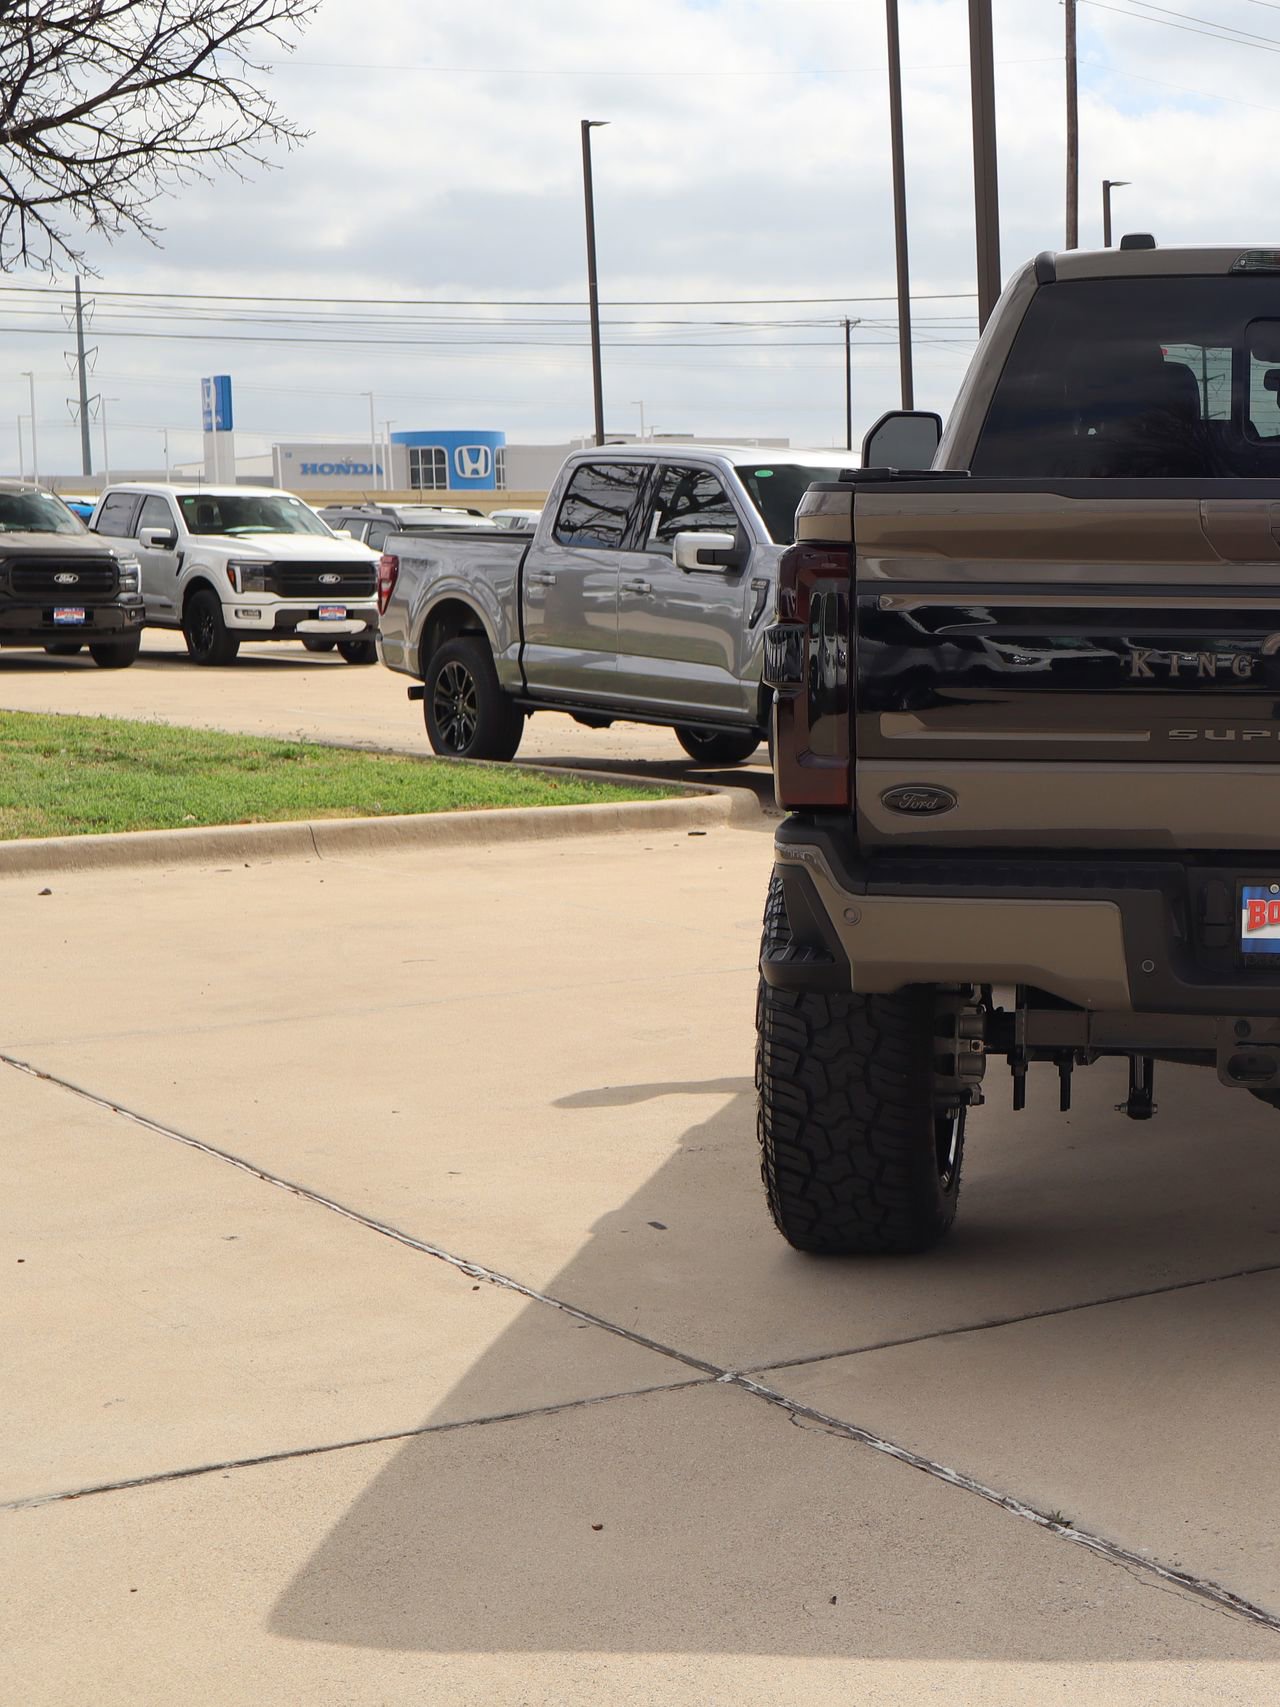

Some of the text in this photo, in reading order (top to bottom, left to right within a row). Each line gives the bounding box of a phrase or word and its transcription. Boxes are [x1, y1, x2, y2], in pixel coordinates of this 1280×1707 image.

[300, 463, 384, 475] HONDA
[1129, 650, 1253, 677] KING
[898, 792, 938, 809] Ford
